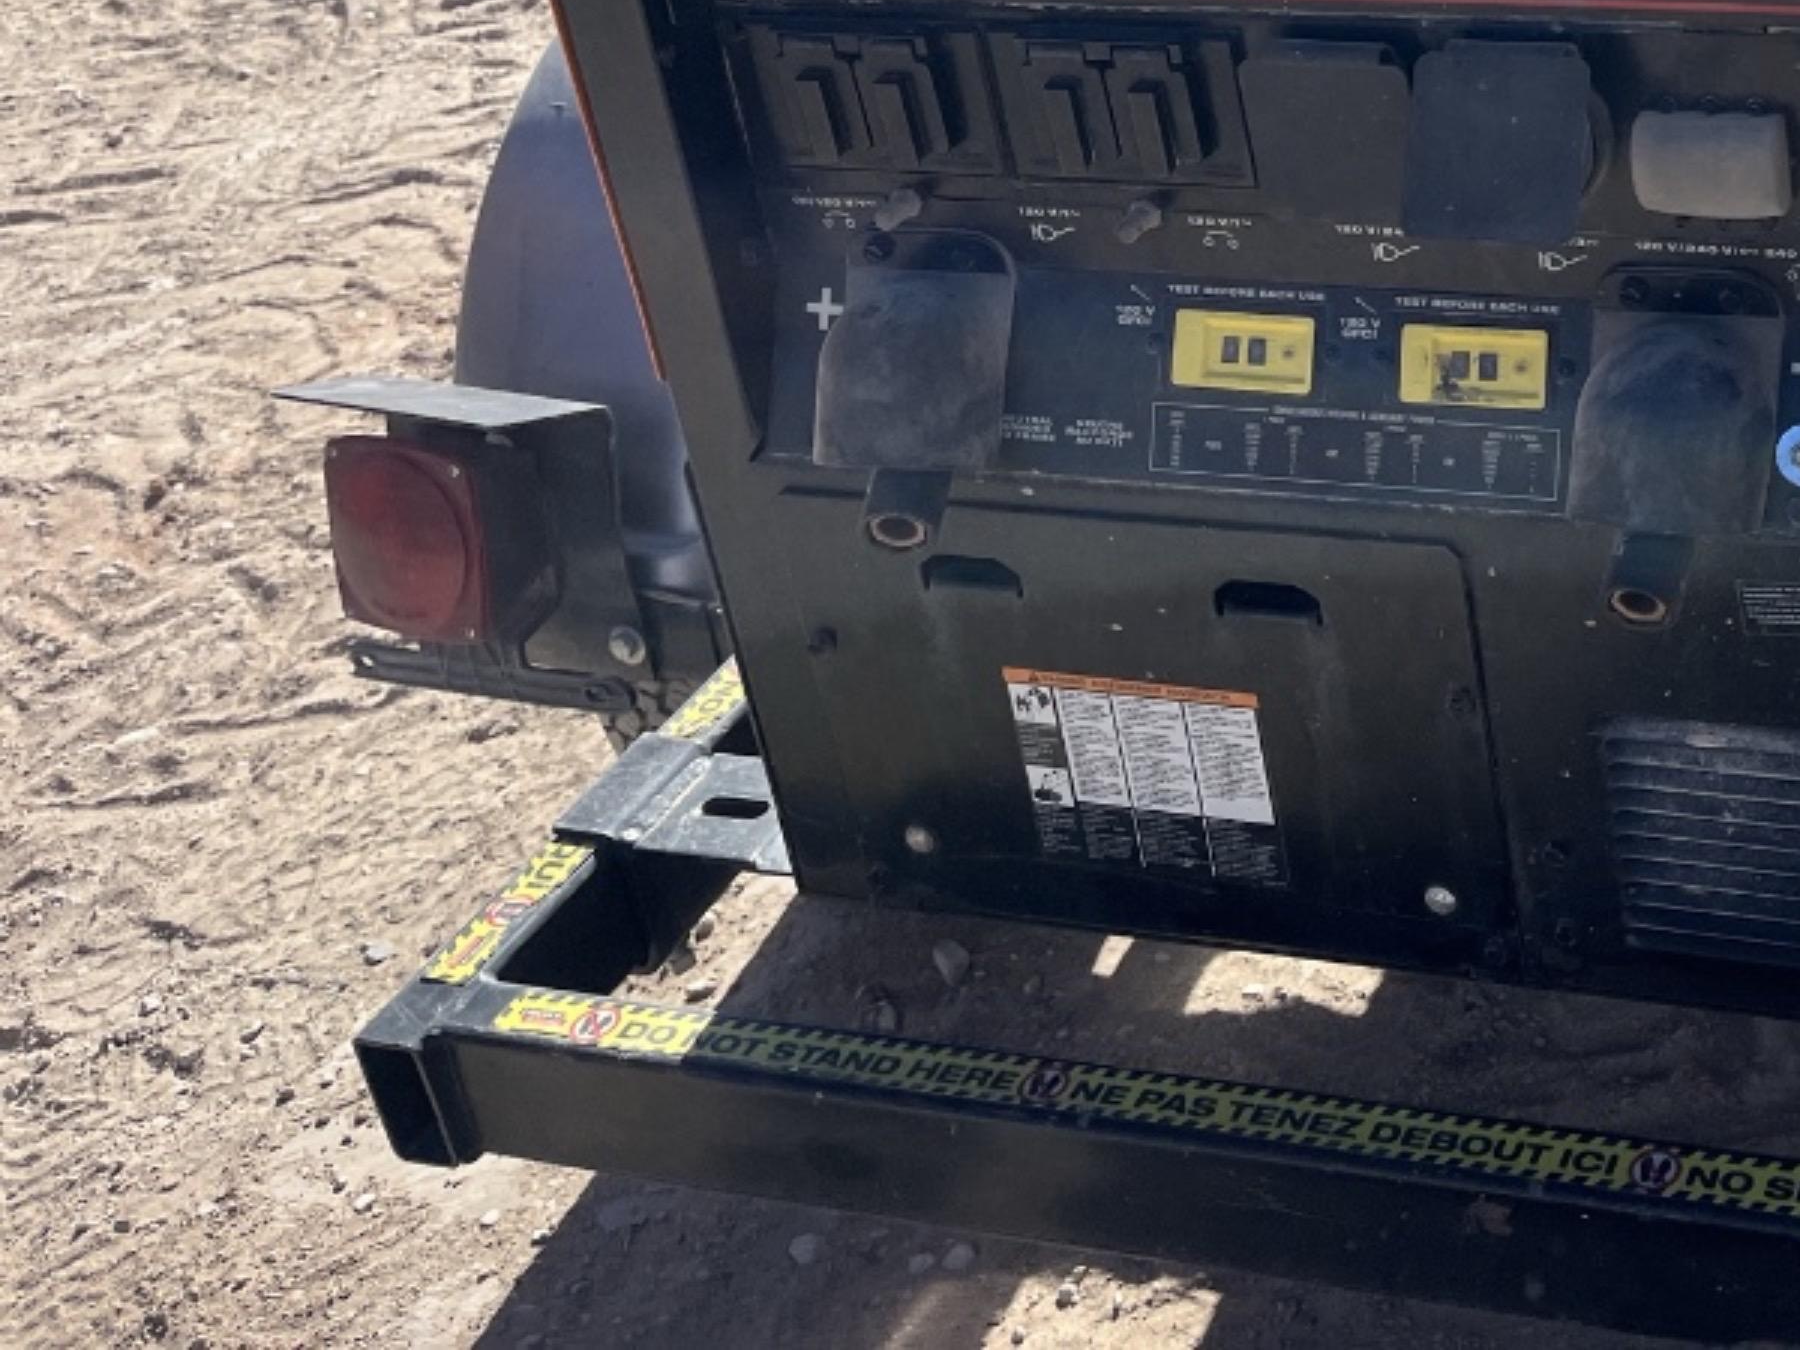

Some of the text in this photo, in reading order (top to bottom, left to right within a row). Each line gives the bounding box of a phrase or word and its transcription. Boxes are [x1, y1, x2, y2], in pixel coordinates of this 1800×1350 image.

[1168, 283, 1200, 296] TEST
[1394, 296, 1428, 308] TEST
[617, 1021, 677, 1045] DO
[681, 1030, 758, 1058] NOT
[769, 1036, 902, 1076] STAND
[906, 1059, 1022, 1092] HERE
[1070, 1081, 1126, 1107] NE
[1134, 1087, 1217, 1118] PAS
[1229, 1099, 1359, 1138] TENEZ
[1368, 1119, 1553, 1164] DEBOUT
[1558, 1150, 1619, 1176] ICI
[1684, 1168, 1755, 1195] NO
